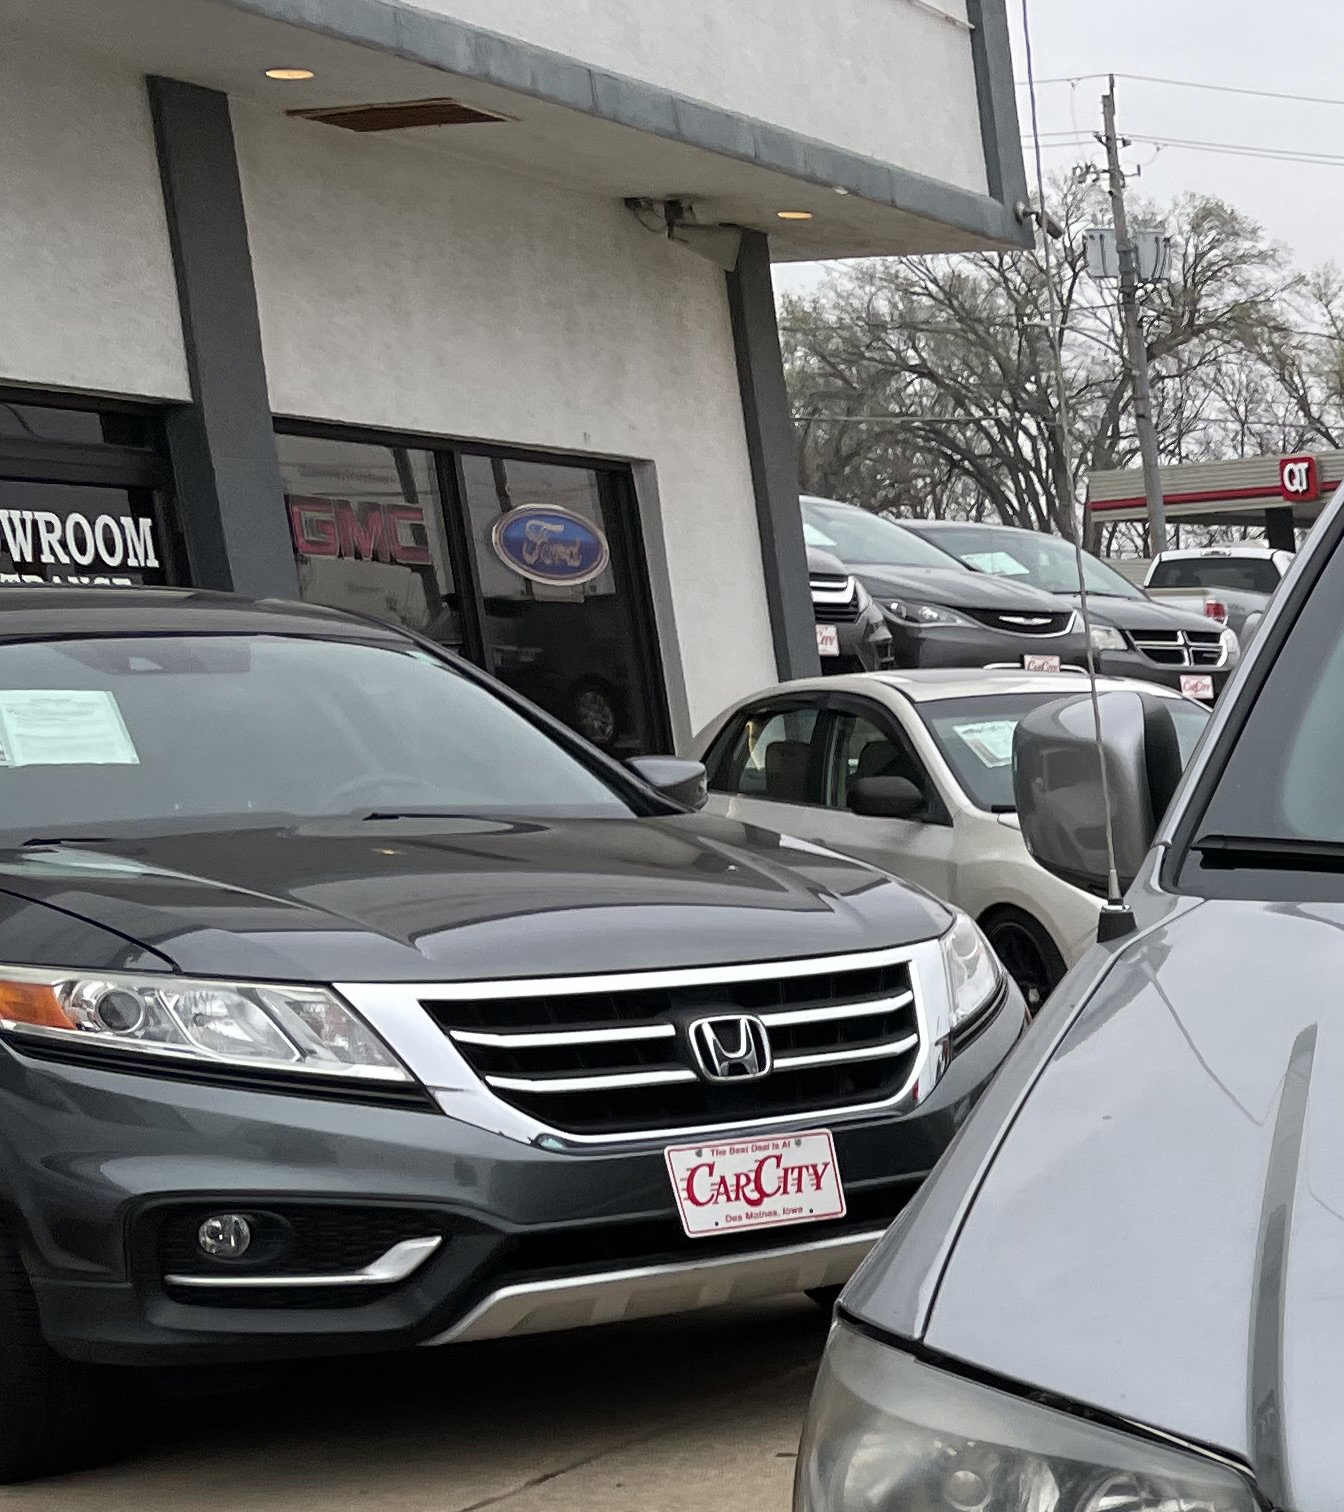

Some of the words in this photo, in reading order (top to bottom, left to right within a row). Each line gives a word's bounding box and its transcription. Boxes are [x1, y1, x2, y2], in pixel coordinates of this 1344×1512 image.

[1283, 462, 1309, 493] QT
[290, 500, 433, 566] GMC
[522, 519, 583, 568] Ford
